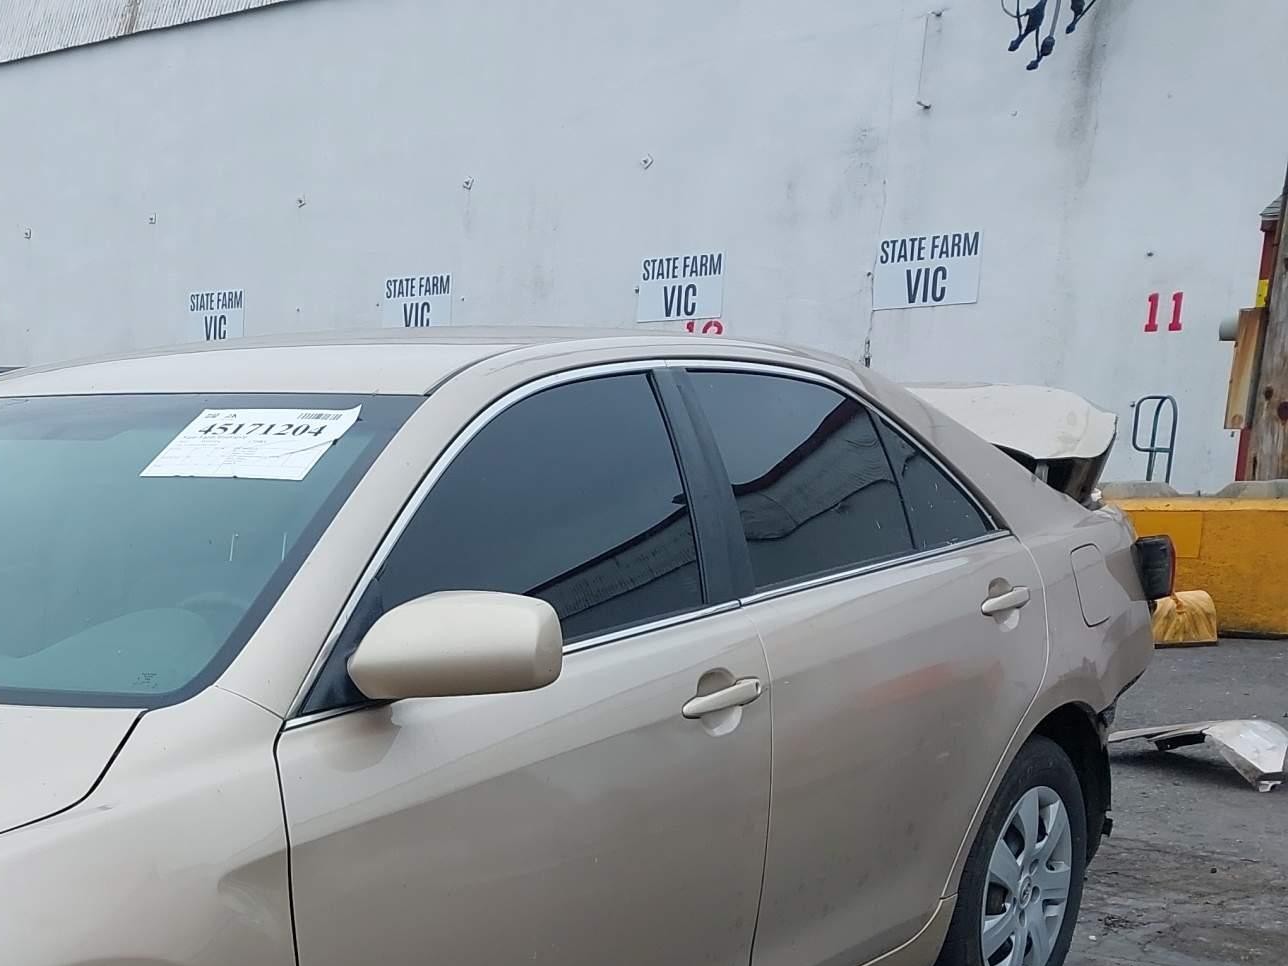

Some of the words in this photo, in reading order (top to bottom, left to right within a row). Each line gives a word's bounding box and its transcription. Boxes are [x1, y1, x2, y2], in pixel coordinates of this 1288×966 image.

[880, 237, 927, 264] STATE
[930, 231, 980, 260] FARM
[642, 257, 679, 281] STATE
[682, 253, 722, 278] FARM
[386, 278, 416, 299] STATE
[418, 275, 450, 296] FARM
[906, 266, 947, 304] VIC
[190, 292, 215, 311] STATE
[217, 290, 243, 310] FARM
[663, 283, 697, 317] VIC
[1144, 291, 1184, 333] 11
[204, 314, 227, 341] VIC
[403, 301, 431, 328] VIC
[198, 423, 328, 437] 45171204
